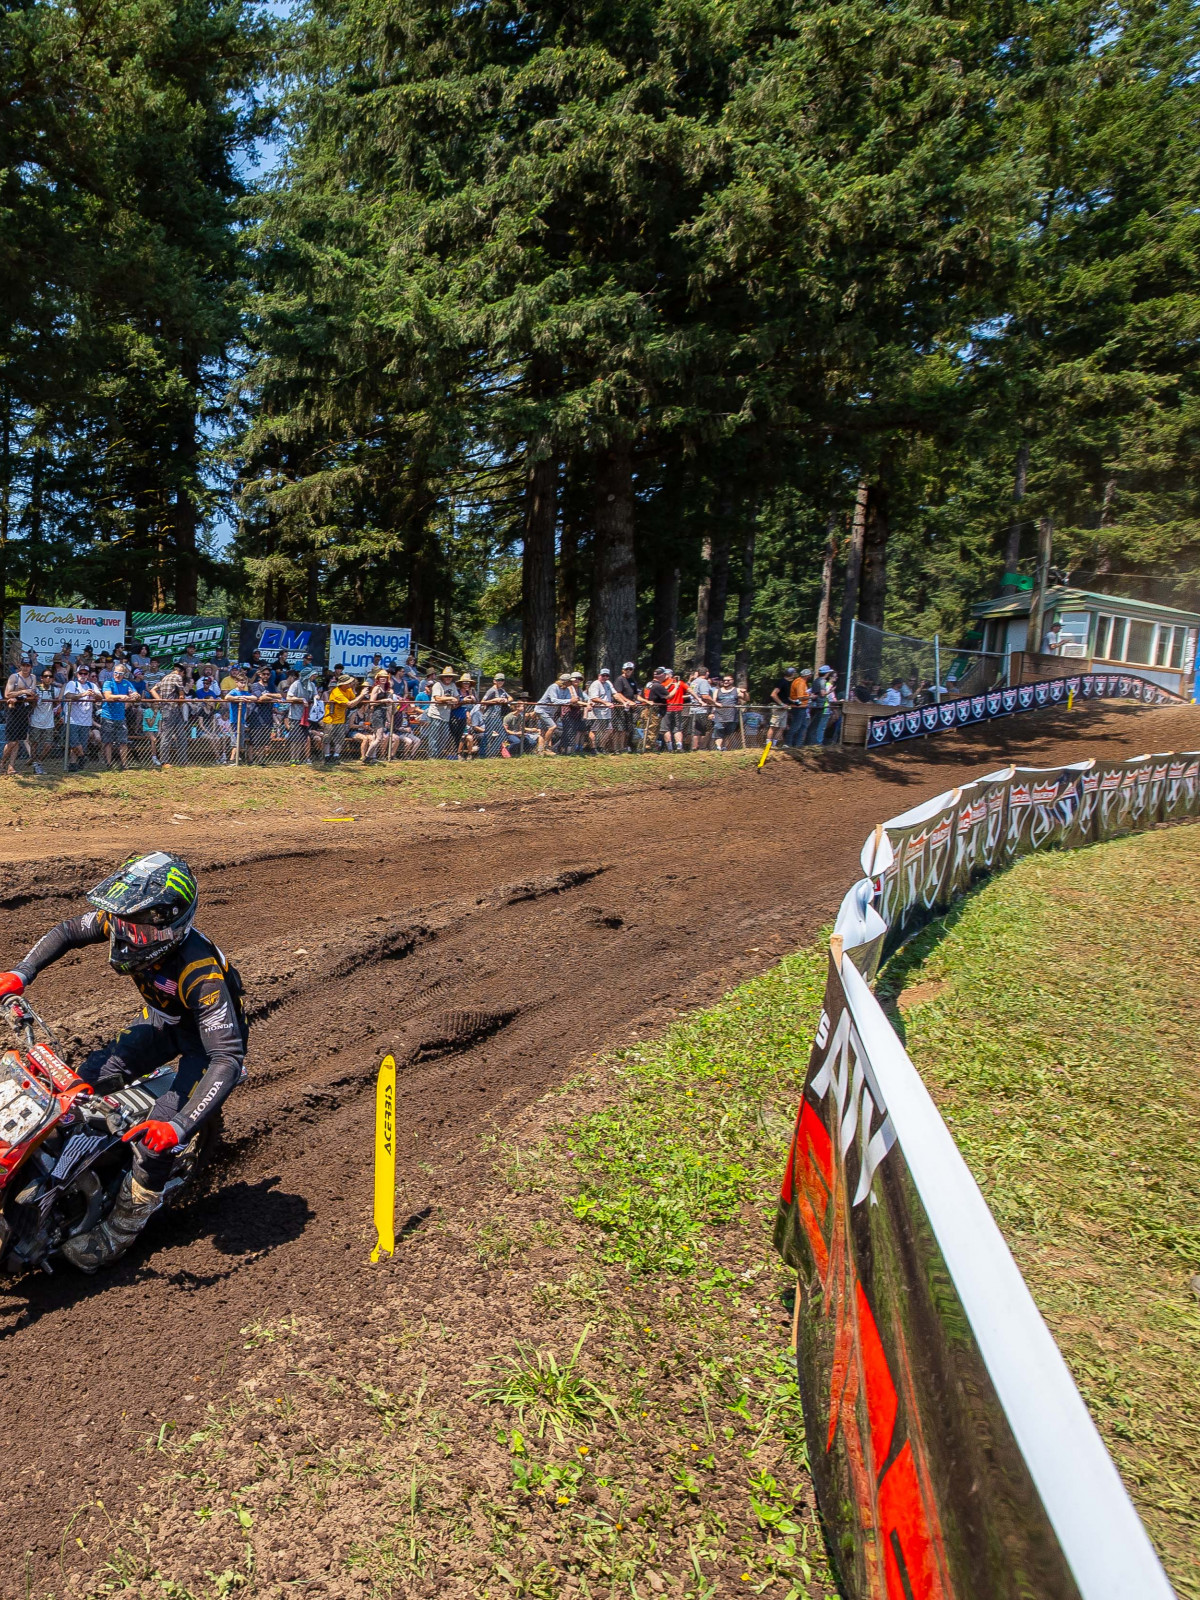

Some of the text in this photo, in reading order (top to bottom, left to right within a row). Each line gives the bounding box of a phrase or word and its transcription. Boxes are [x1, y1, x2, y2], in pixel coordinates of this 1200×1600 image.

[143, 627, 222, 648] FUSION
[333, 629, 410, 652] Washougal
[342, 651, 398, 668] Lumer
[204, 1023, 234, 1033] HONDA
[189, 1080, 223, 1122] HONDA
[383, 1084, 394, 1156] ACERBIS
